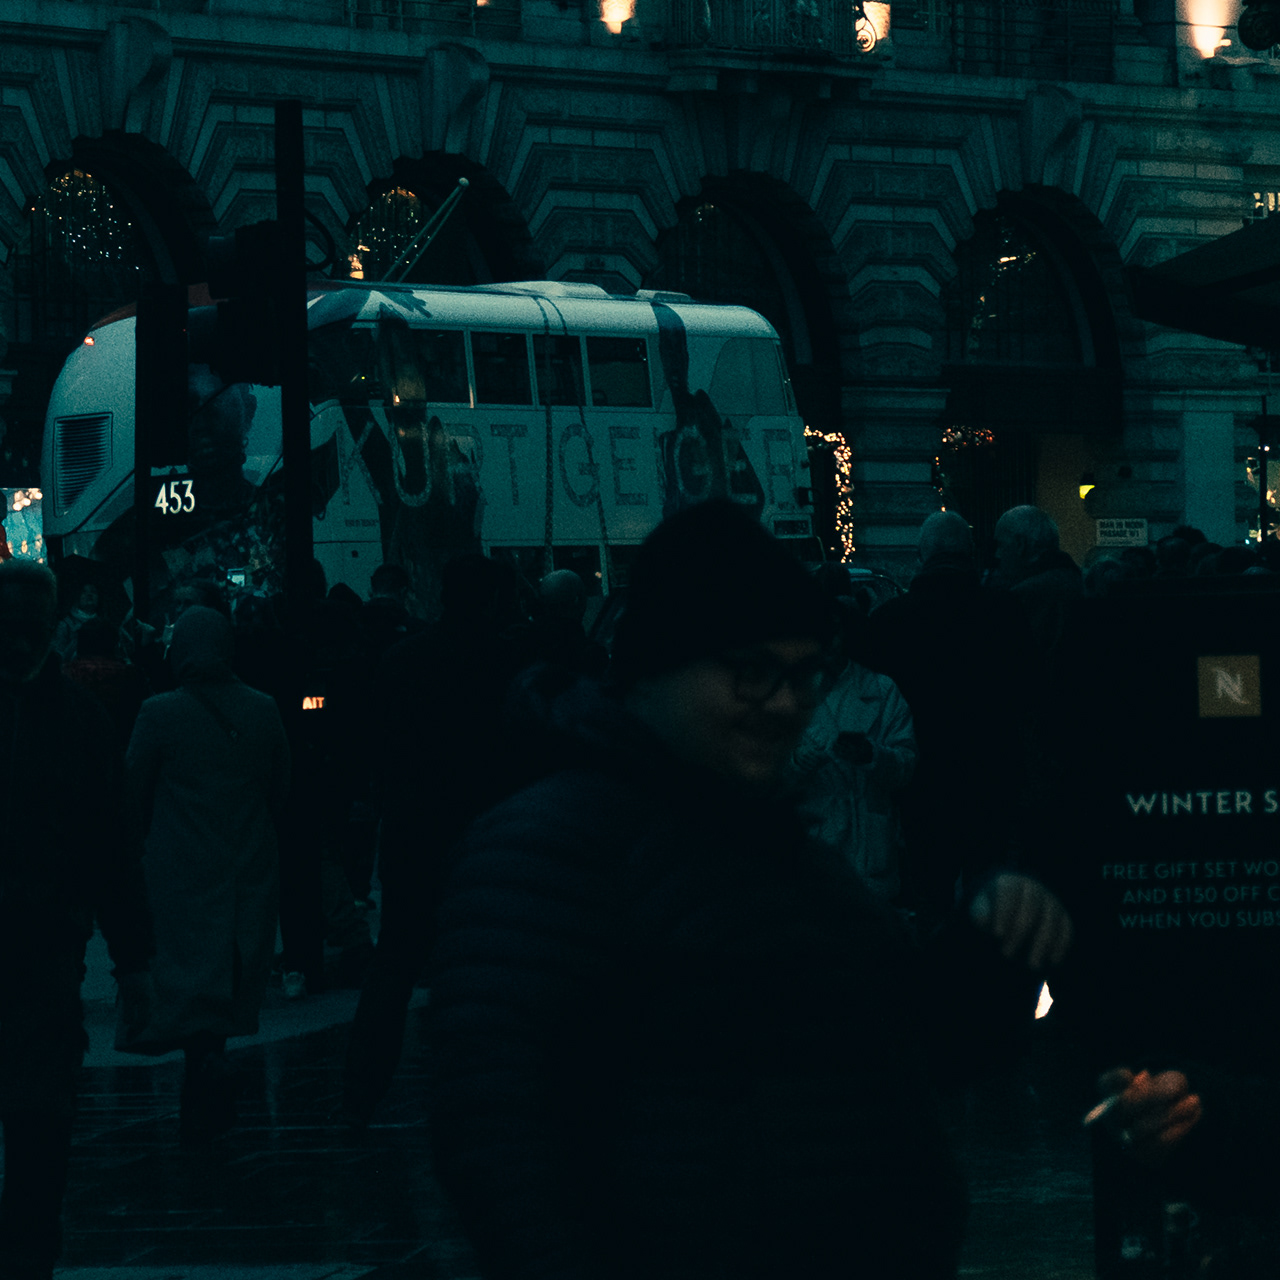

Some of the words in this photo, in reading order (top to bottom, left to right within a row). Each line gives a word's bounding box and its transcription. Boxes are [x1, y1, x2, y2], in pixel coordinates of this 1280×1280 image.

[153, 478, 196, 516] 453
[302, 696, 325, 710] AIT
[1126, 790, 1253, 815] WINTER
[1102, 863, 1148, 881] FREE
[1154, 862, 1199, 880] GIFT
[1204, 861, 1238, 879] SET
[1122, 888, 1167, 905] AND
[1223, 885, 1260, 903] OFF
[1119, 912, 1181, 930] WHEN
[1188, 911, 1230, 928] YOU
